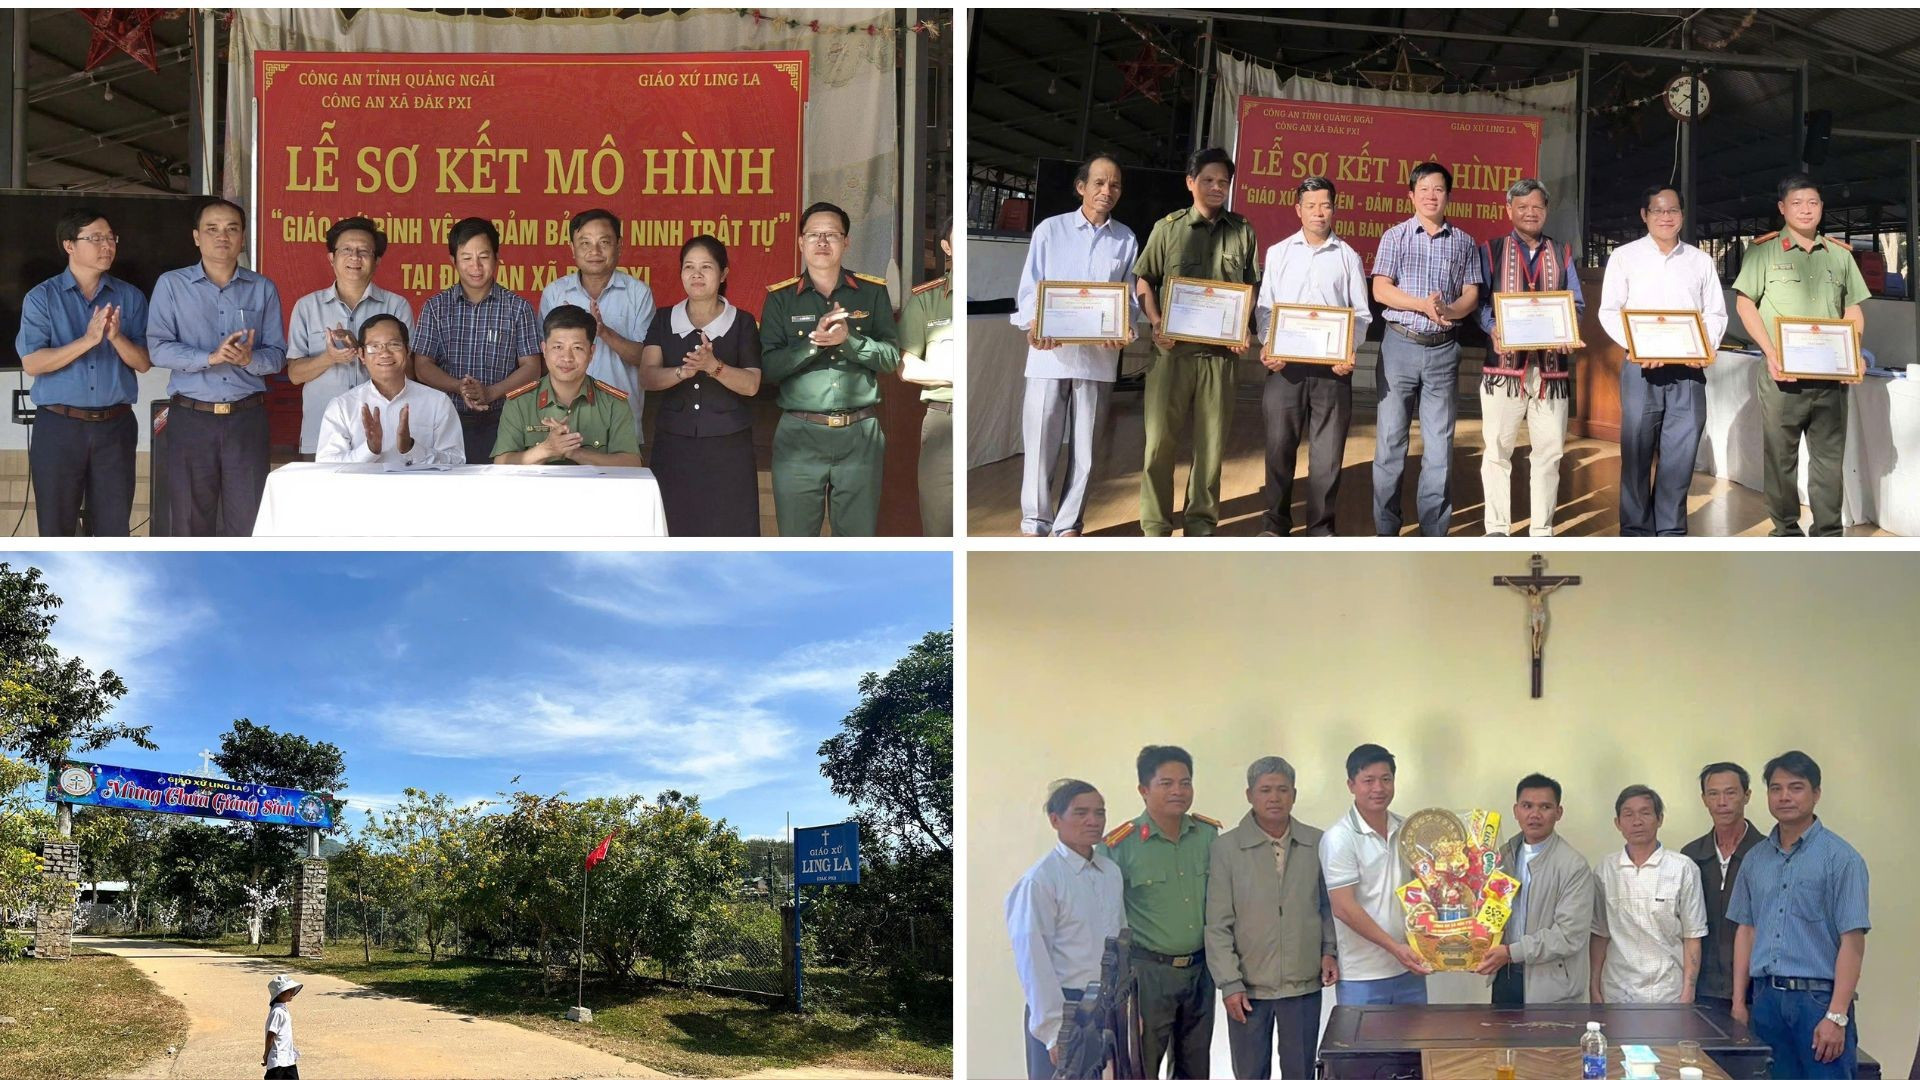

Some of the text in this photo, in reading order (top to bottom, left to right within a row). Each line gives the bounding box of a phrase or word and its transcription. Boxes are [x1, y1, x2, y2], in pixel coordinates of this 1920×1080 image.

[299, 69, 496, 88] CÔNG AN TỈNH QUẢNG NGÃI
[638, 70, 761, 87] GIÁO XỨ LING LA
[321, 92, 472, 109] CÔNG AN XÃ ĐĂK PXI
[1288, 111, 1300, 120] AN
[1300, 124, 1312, 133] AN
[285, 119, 775, 196] LỄ SƠ KẾT MÔ HÌNH
[1250, 135, 1284, 177] LỄ
[1291, 151, 1330, 179] SƠ
[1335, 141, 1390, 183] KẾT
[1452, 154, 1523, 191] HÌNH
[1365, 192, 1393, 214] ĐẢM
[1444, 201, 1473, 219] NINH
[1476, 201, 1505, 223] TRẬT
[631, 219, 684, 247] NINH
[1335, 219, 1356, 240] ĐỊA
[401, 263, 433, 296] TẠI
[209, 782, 231, 790] LING
[260, 800, 296, 818] Sinh
[810, 847, 829, 856] GIÁO
[802, 856, 852, 874] LING LA
